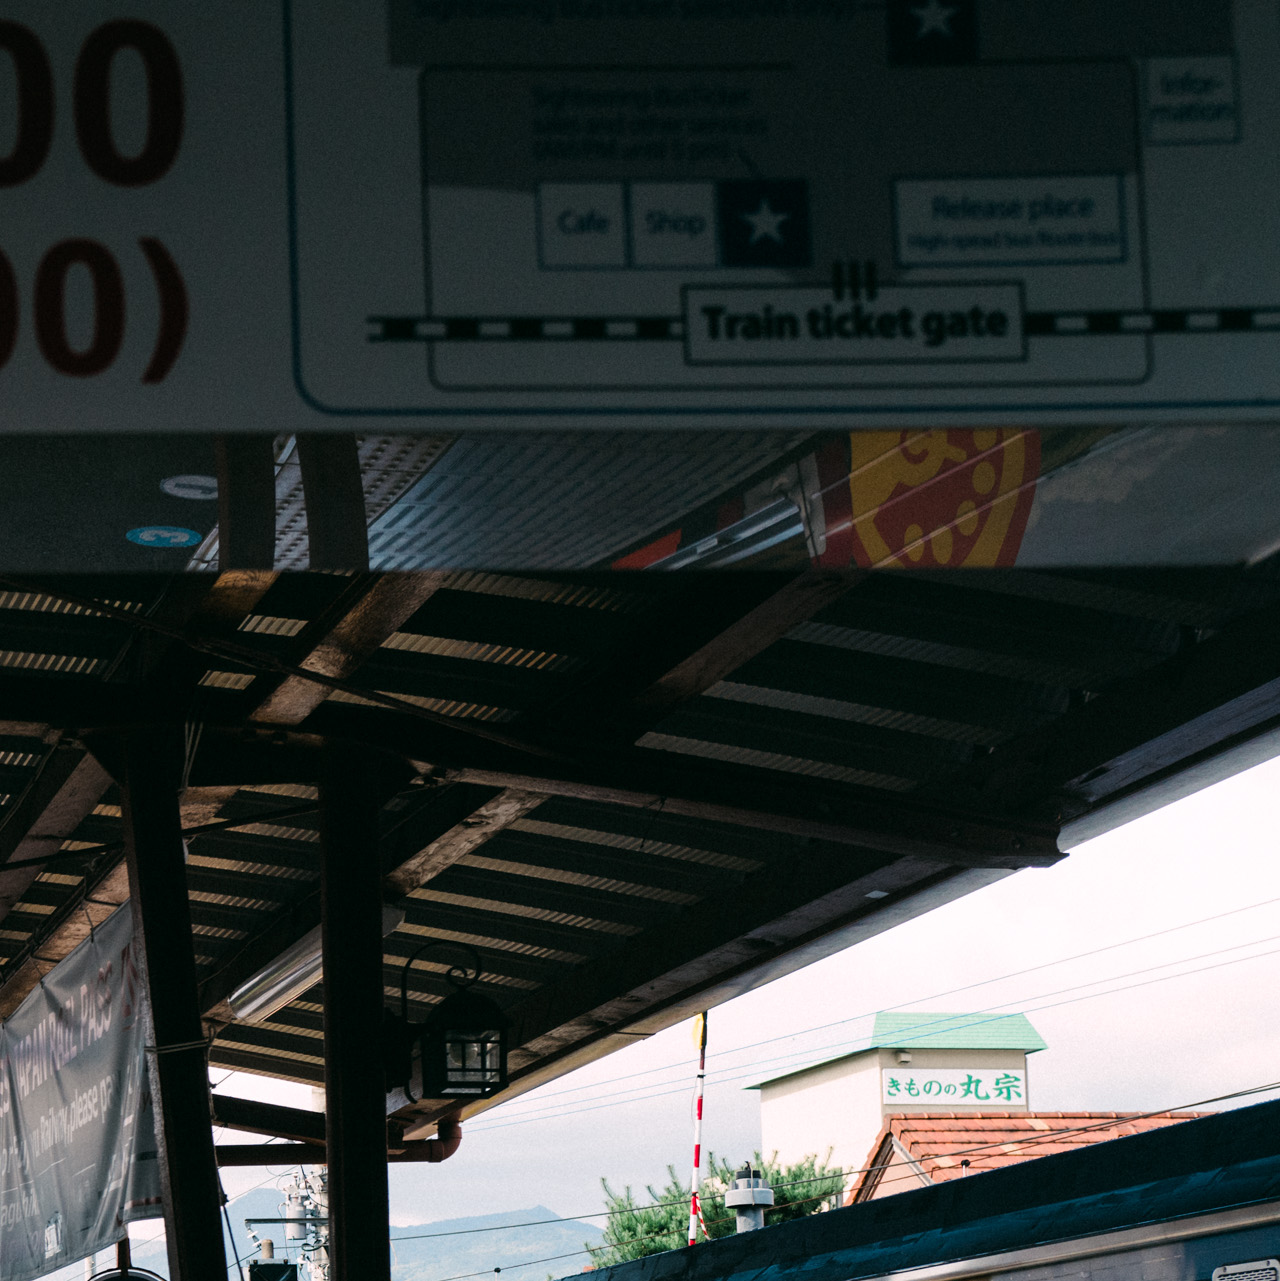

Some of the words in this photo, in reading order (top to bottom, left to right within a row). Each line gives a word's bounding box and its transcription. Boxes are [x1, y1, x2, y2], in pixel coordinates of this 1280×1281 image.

[558, 211, 609, 234] Cafe
[645, 209, 706, 239] Shop
[930, 193, 1023, 221] Release
[1027, 191, 1095, 227] place
[701, 304, 798, 340] Train
[807, 304, 912, 340] ticket
[921, 307, 1009, 347] gate
[885, 1072, 1024, 1103] きものの丸宗
